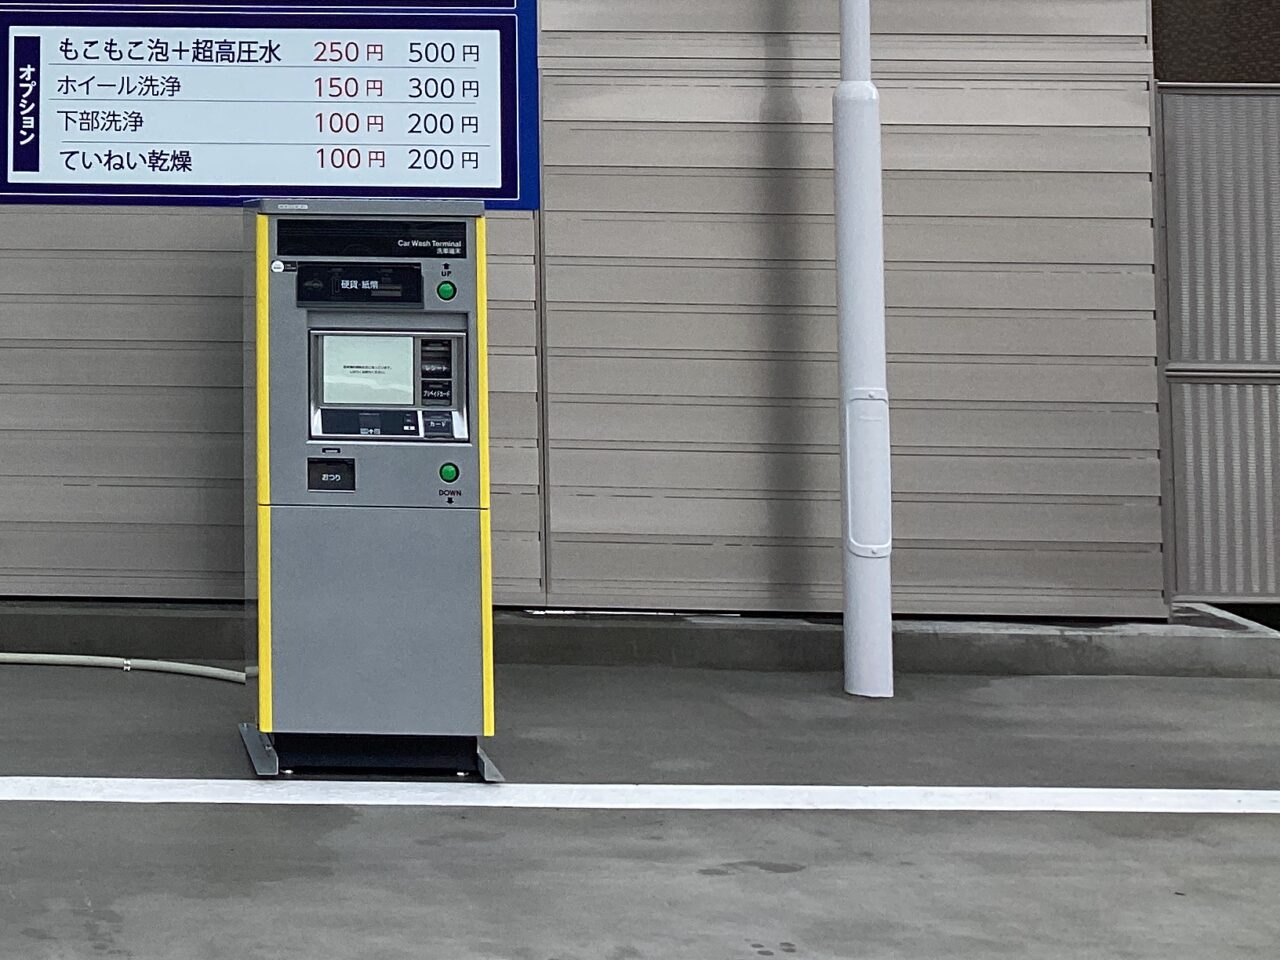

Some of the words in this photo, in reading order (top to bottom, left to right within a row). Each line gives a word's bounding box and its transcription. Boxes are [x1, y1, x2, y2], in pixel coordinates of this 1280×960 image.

[59, 38, 282, 63] もこもこ泡+超高圧水
[313, 42, 359, 62] 250
[408, 43, 455, 62] 500
[57, 75, 182, 97] ホイール洗浄
[314, 77, 359, 97] 150
[408, 78, 455, 98] 300
[18, 64, 37, 145] オプション
[57, 110, 144, 132] 下部洗浄
[315, 113, 360, 133] 100
[408, 113, 455, 134] 200
[59, 149, 193, 172] ていねい乾燥
[316, 148, 361, 168] 100
[408, 149, 455, 170] 200
[321, 473, 341, 481] おつり
